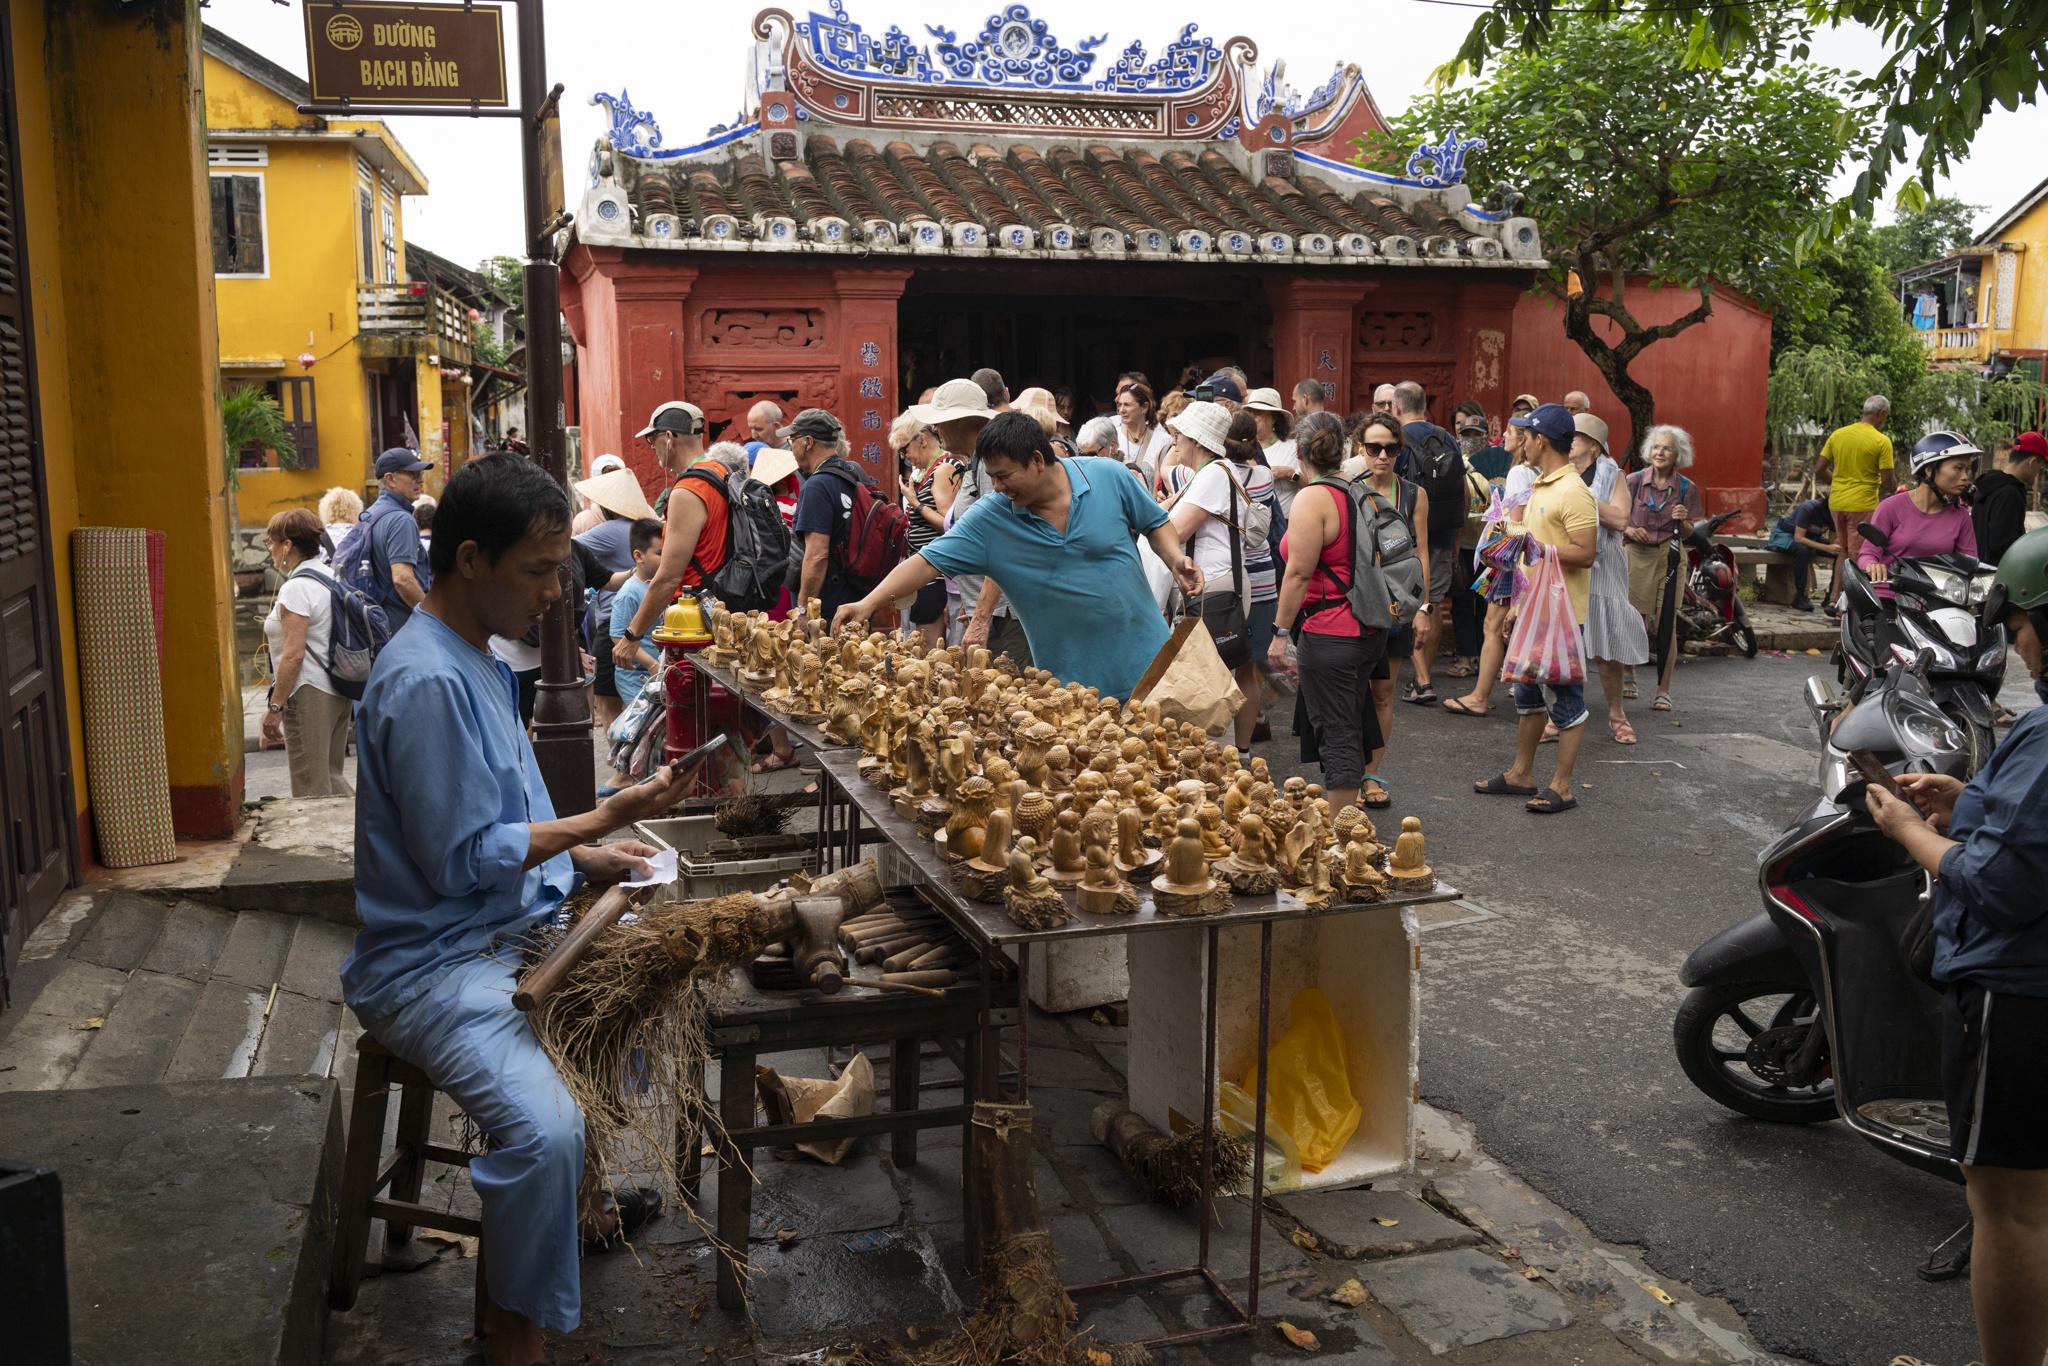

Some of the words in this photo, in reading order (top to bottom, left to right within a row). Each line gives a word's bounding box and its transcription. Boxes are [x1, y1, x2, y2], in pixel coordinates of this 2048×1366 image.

[373, 19, 436, 48] ĐƯỜNG
[360, 59, 408, 90] BẠCH
[411, 52, 459, 87] ĐẰNG
